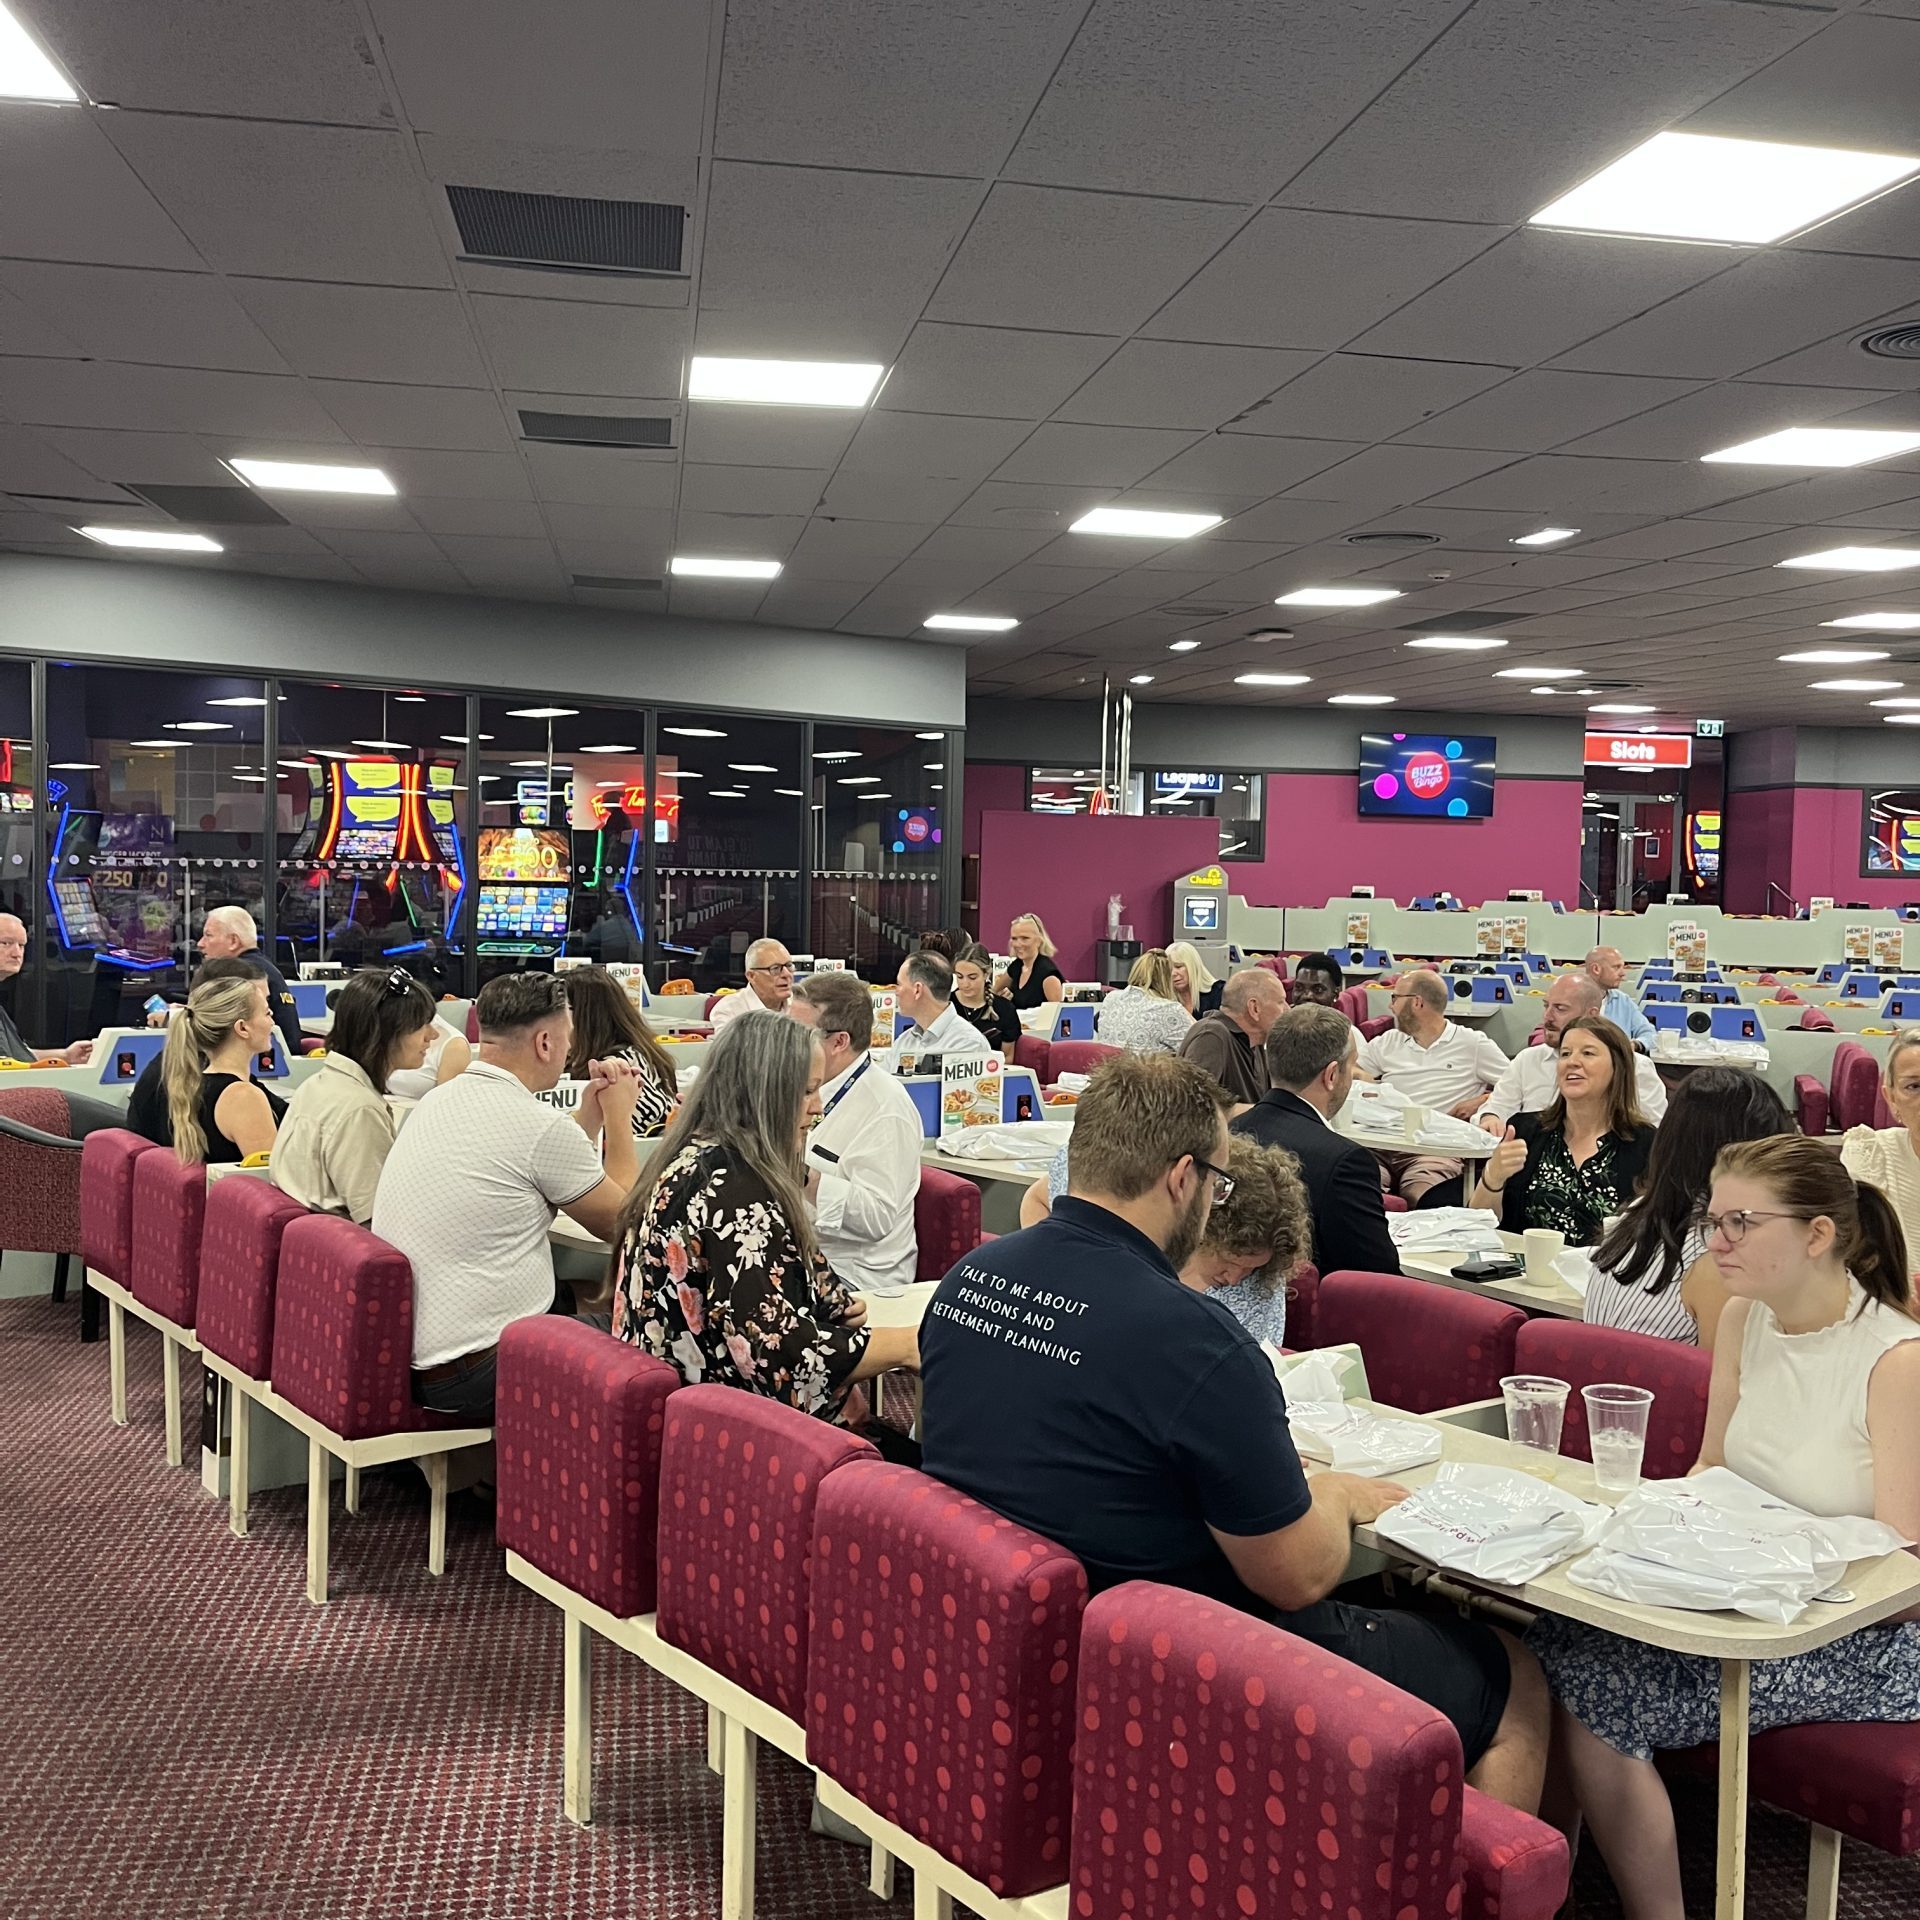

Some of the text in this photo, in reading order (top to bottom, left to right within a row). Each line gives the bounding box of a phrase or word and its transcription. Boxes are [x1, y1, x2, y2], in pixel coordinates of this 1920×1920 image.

[1610, 740, 1656, 760] Slots
[1412, 764, 1443, 779] BUZZ
[1162, 772, 1207, 784] Lades
[1414, 776, 1443, 788] Bingo
[1190, 875, 1223, 886] Change
[1676, 932, 1697, 941] MENU
[1847, 927, 1863, 935] MENU
[816, 963, 835, 973] MENU
[994, 960, 1010, 970] MEN
[608, 967, 631, 978] MENU
[945, 1060, 983, 1082] MENU
[960, 1265, 1089, 1316] TALK TO ME ABOUT
[957, 1287, 1055, 1331] PENSIONS AND
[932, 1301, 1082, 1366] RETIREMENT PLANNING
